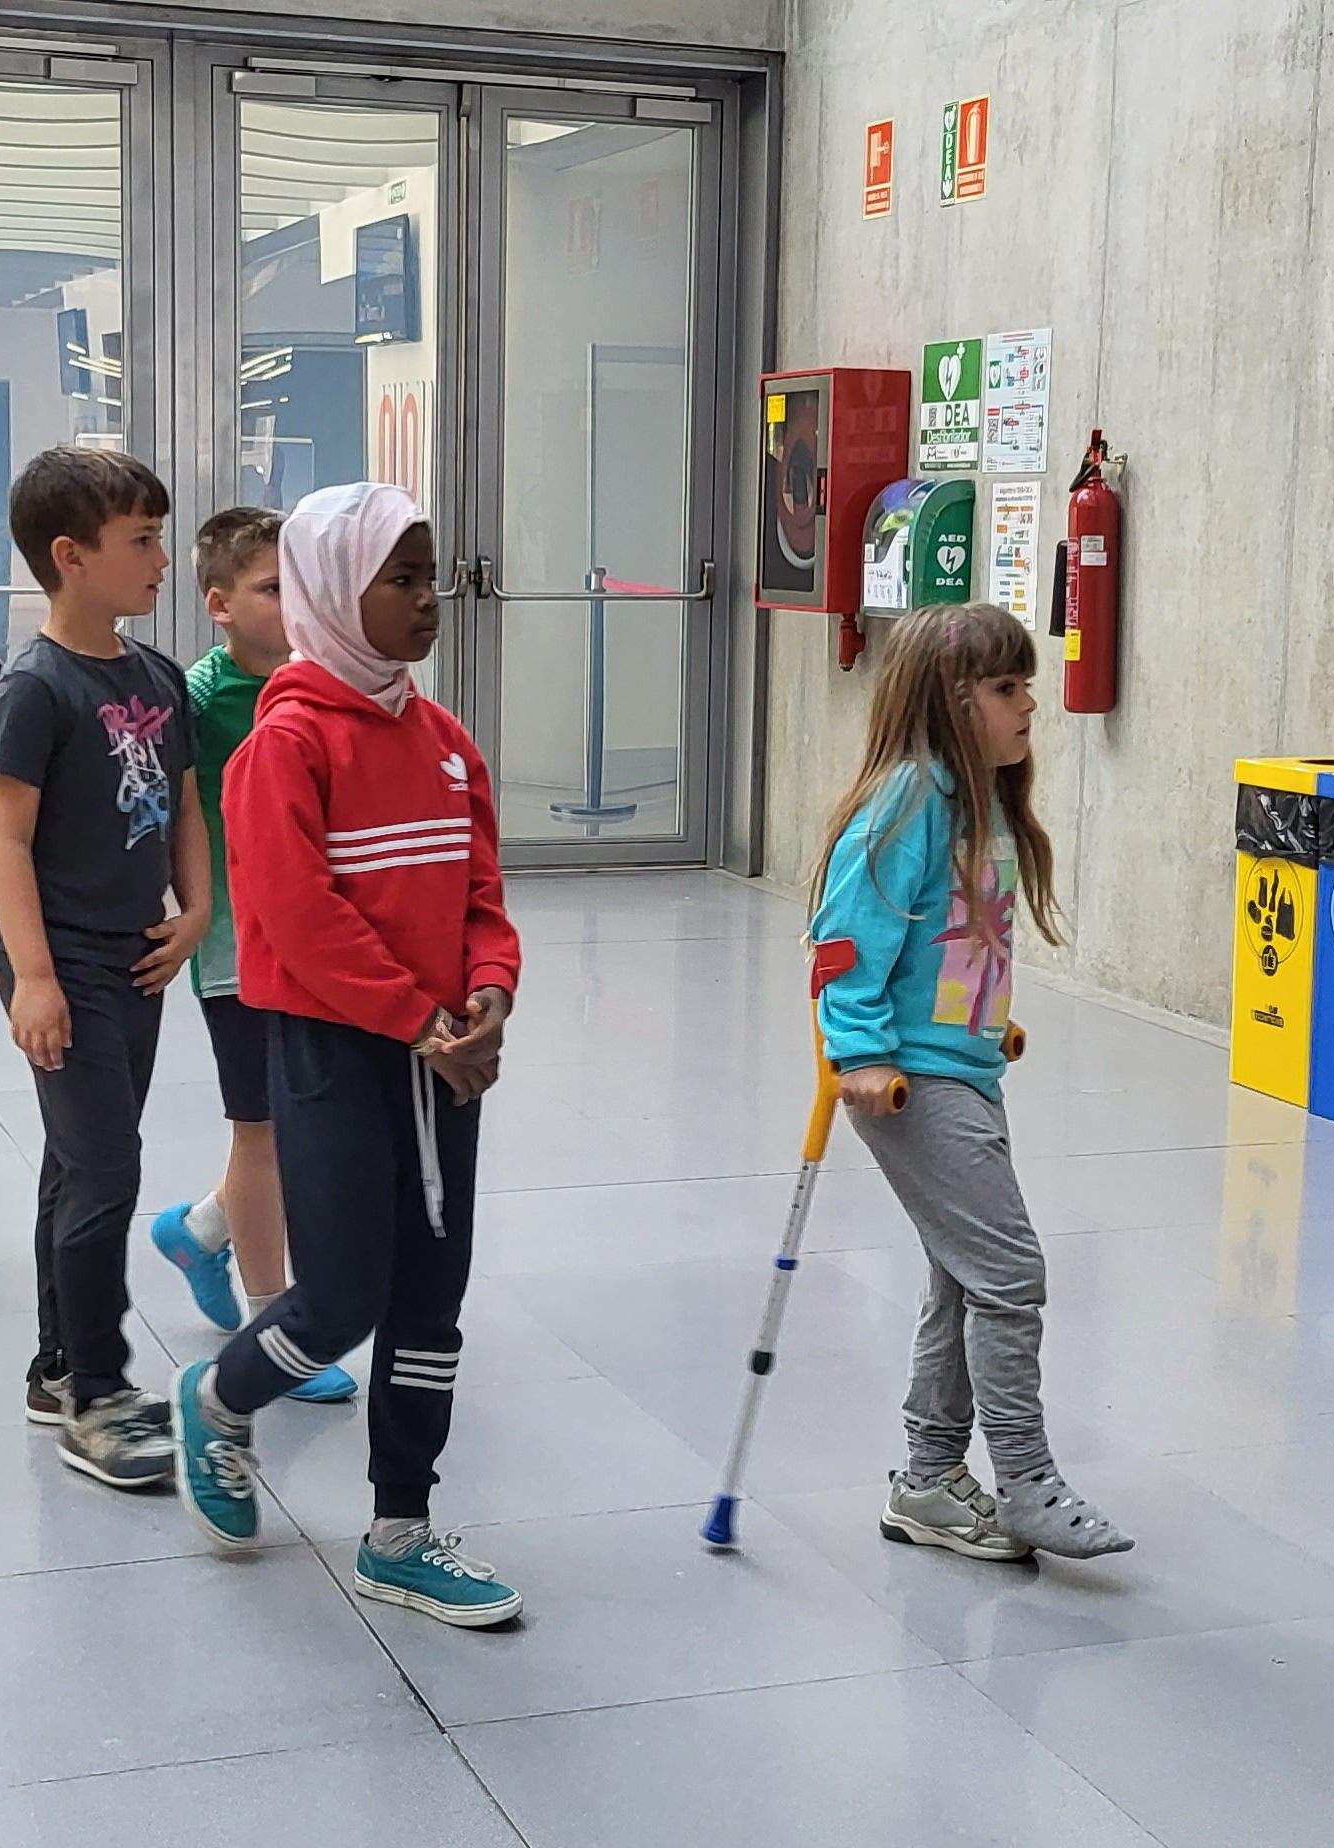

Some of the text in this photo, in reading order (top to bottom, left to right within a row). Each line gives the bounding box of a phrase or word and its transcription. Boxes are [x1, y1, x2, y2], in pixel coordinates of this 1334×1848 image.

[944, 402, 970, 427] DEA
[938, 533, 967, 543] AED
[935, 577, 965, 586] DEA
